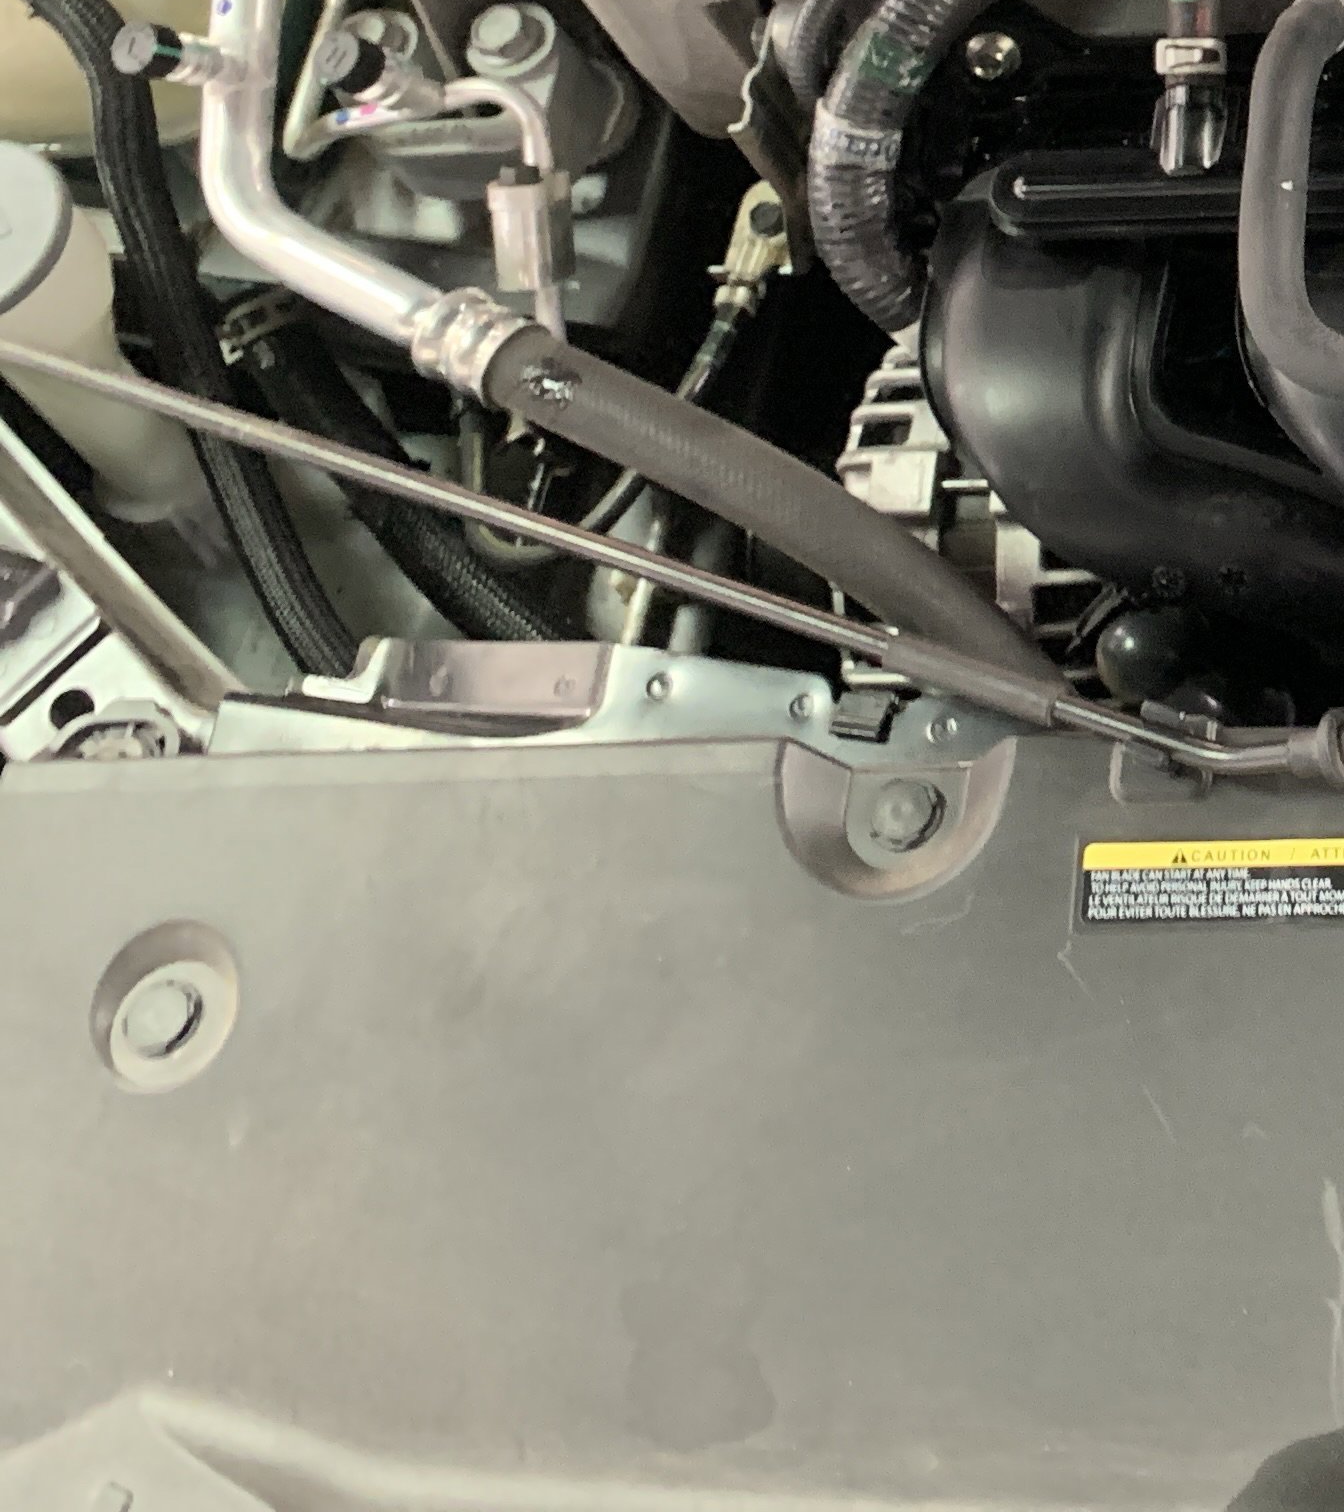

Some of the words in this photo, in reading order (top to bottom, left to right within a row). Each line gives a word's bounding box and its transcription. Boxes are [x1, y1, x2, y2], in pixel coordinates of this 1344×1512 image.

[1191, 849, 1271, 863] CAUTION
[1142, 868, 1163, 881] CAN
[1206, 867, 1226, 880] ANY
[1105, 881, 1129, 894] HELP
[1161, 879, 1207, 892] PERSONAL
[1268, 878, 1300, 890] HANDS
[1088, 894, 1101, 907] LE
[1209, 892, 1223, 904] DE
[1290, 890, 1318, 903] TOUT
[1087, 907, 1117, 920] POUR
[1154, 905, 1187, 918] TOUTE
[1242, 904, 1257, 917] NE
[1257, 904, 1277, 916] PAS
[1278, 903, 1291, 916] EN
